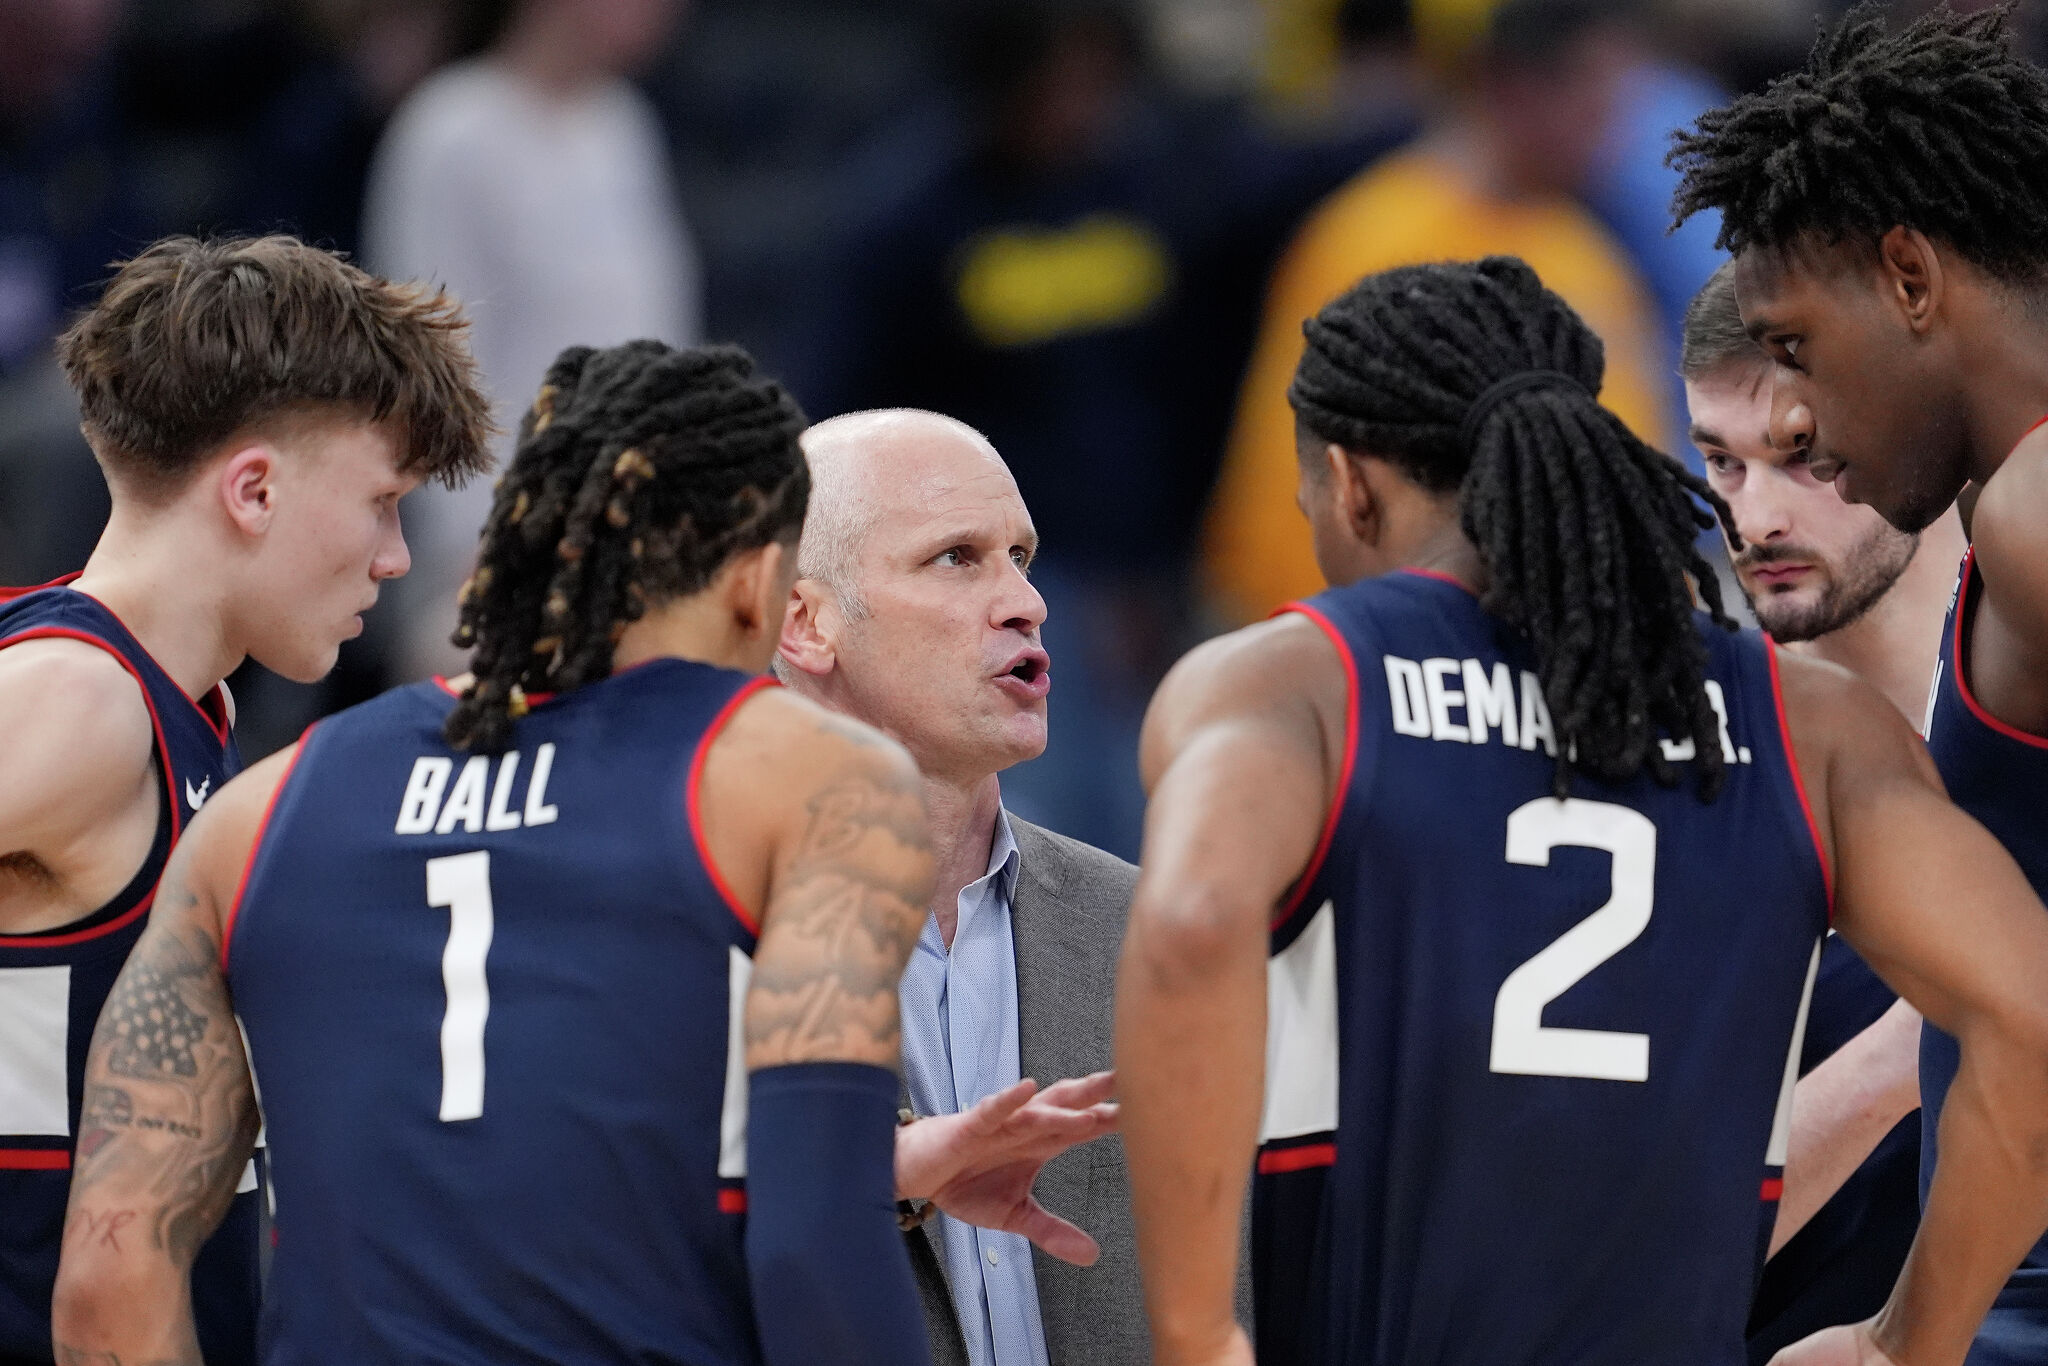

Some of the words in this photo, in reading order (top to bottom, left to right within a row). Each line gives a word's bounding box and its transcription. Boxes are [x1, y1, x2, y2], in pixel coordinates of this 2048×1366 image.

[395, 742, 558, 835] BALL
[1383, 654, 1578, 763] DEMA
[426, 850, 494, 1122] 1
[1489, 796, 1658, 1083] 2
